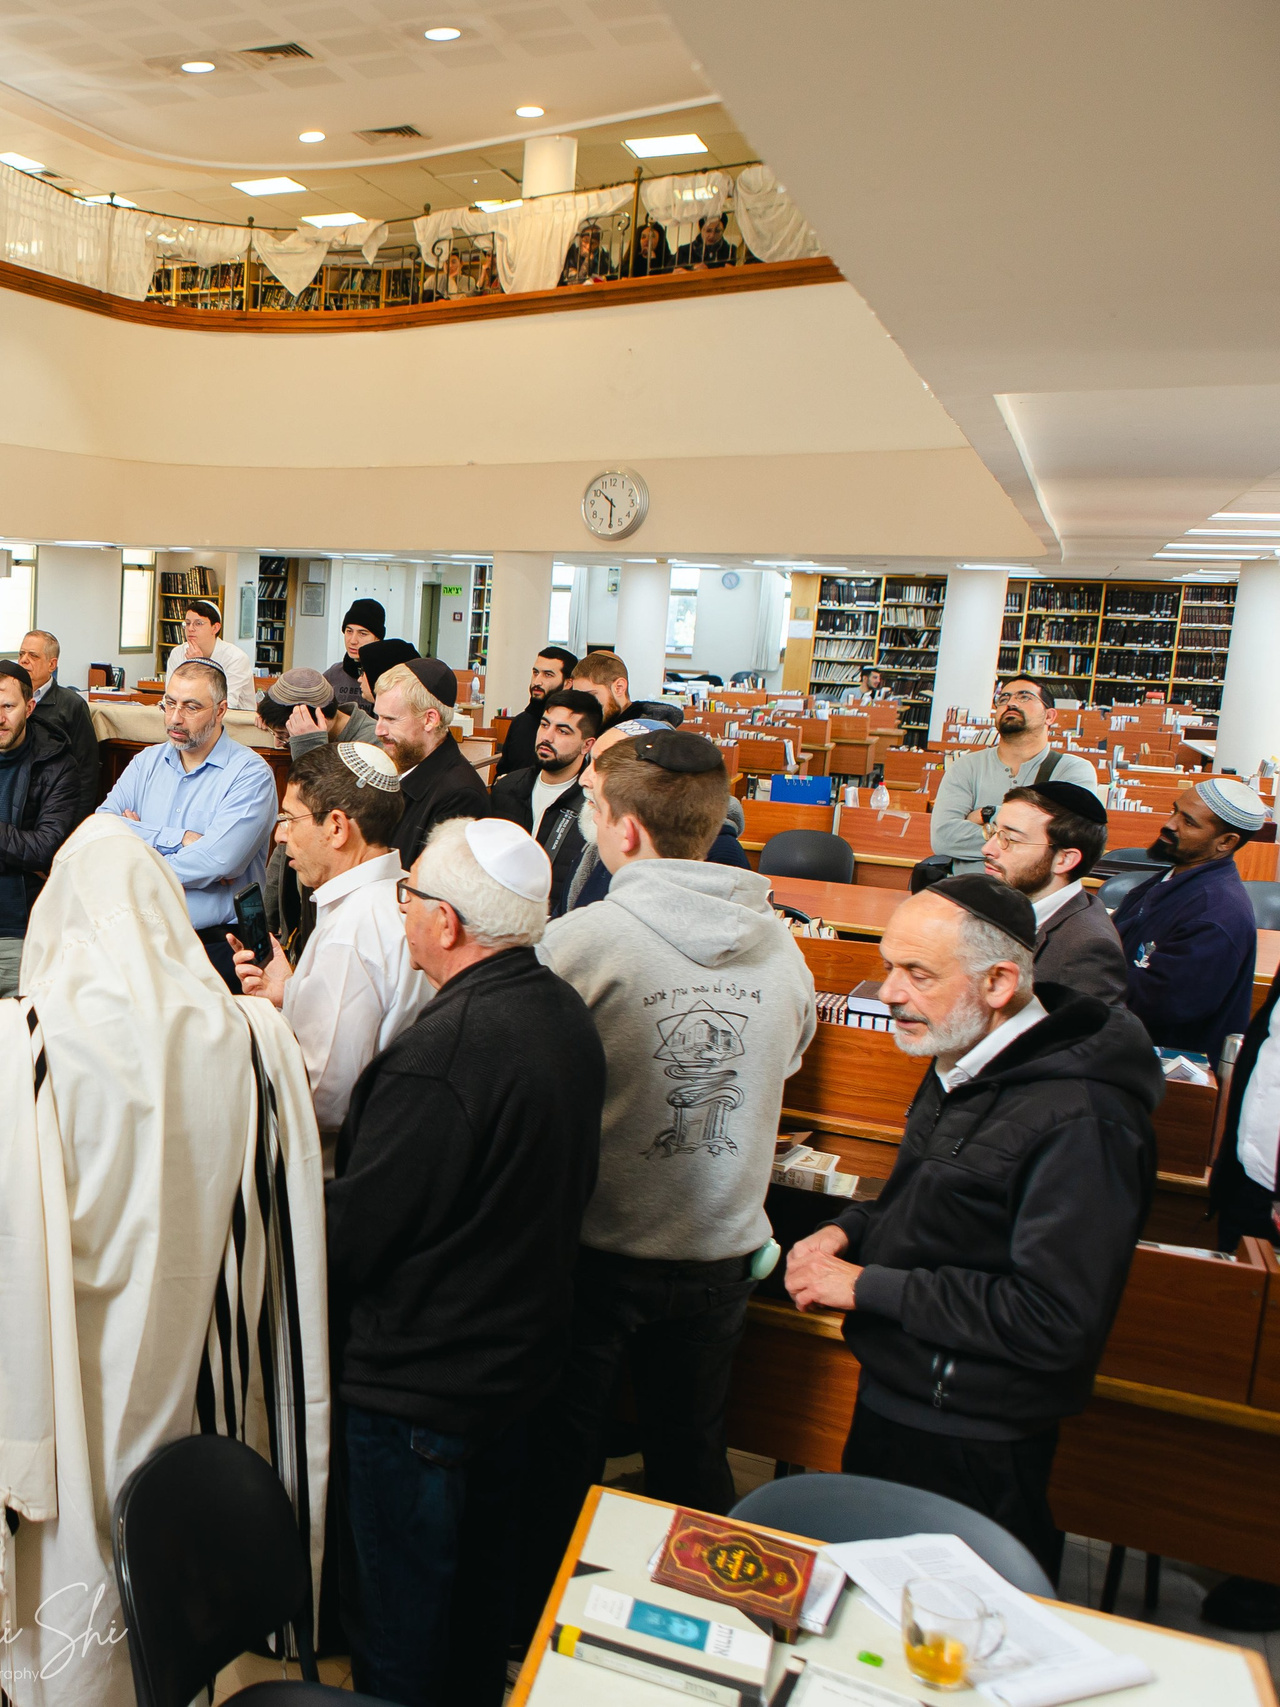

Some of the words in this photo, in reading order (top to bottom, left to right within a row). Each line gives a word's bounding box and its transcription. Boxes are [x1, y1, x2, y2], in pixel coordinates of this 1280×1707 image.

[601, 481, 607, 489] 11
[610, 478, 617, 487] 12
[593, 489, 601, 497] 10
[628, 488, 633, 497] 2
[590, 500, 595, 508] 9
[630, 499, 634, 507] 3
[592, 510, 597, 518] 8
[599, 518, 603, 526] 7
[618, 518, 622, 526] 5
[443, 586, 462, 594] יציאה
[340, 686, 348, 694] GO
[713, 980, 722, 993] לא
[751, 989, 761, 1004] עם
